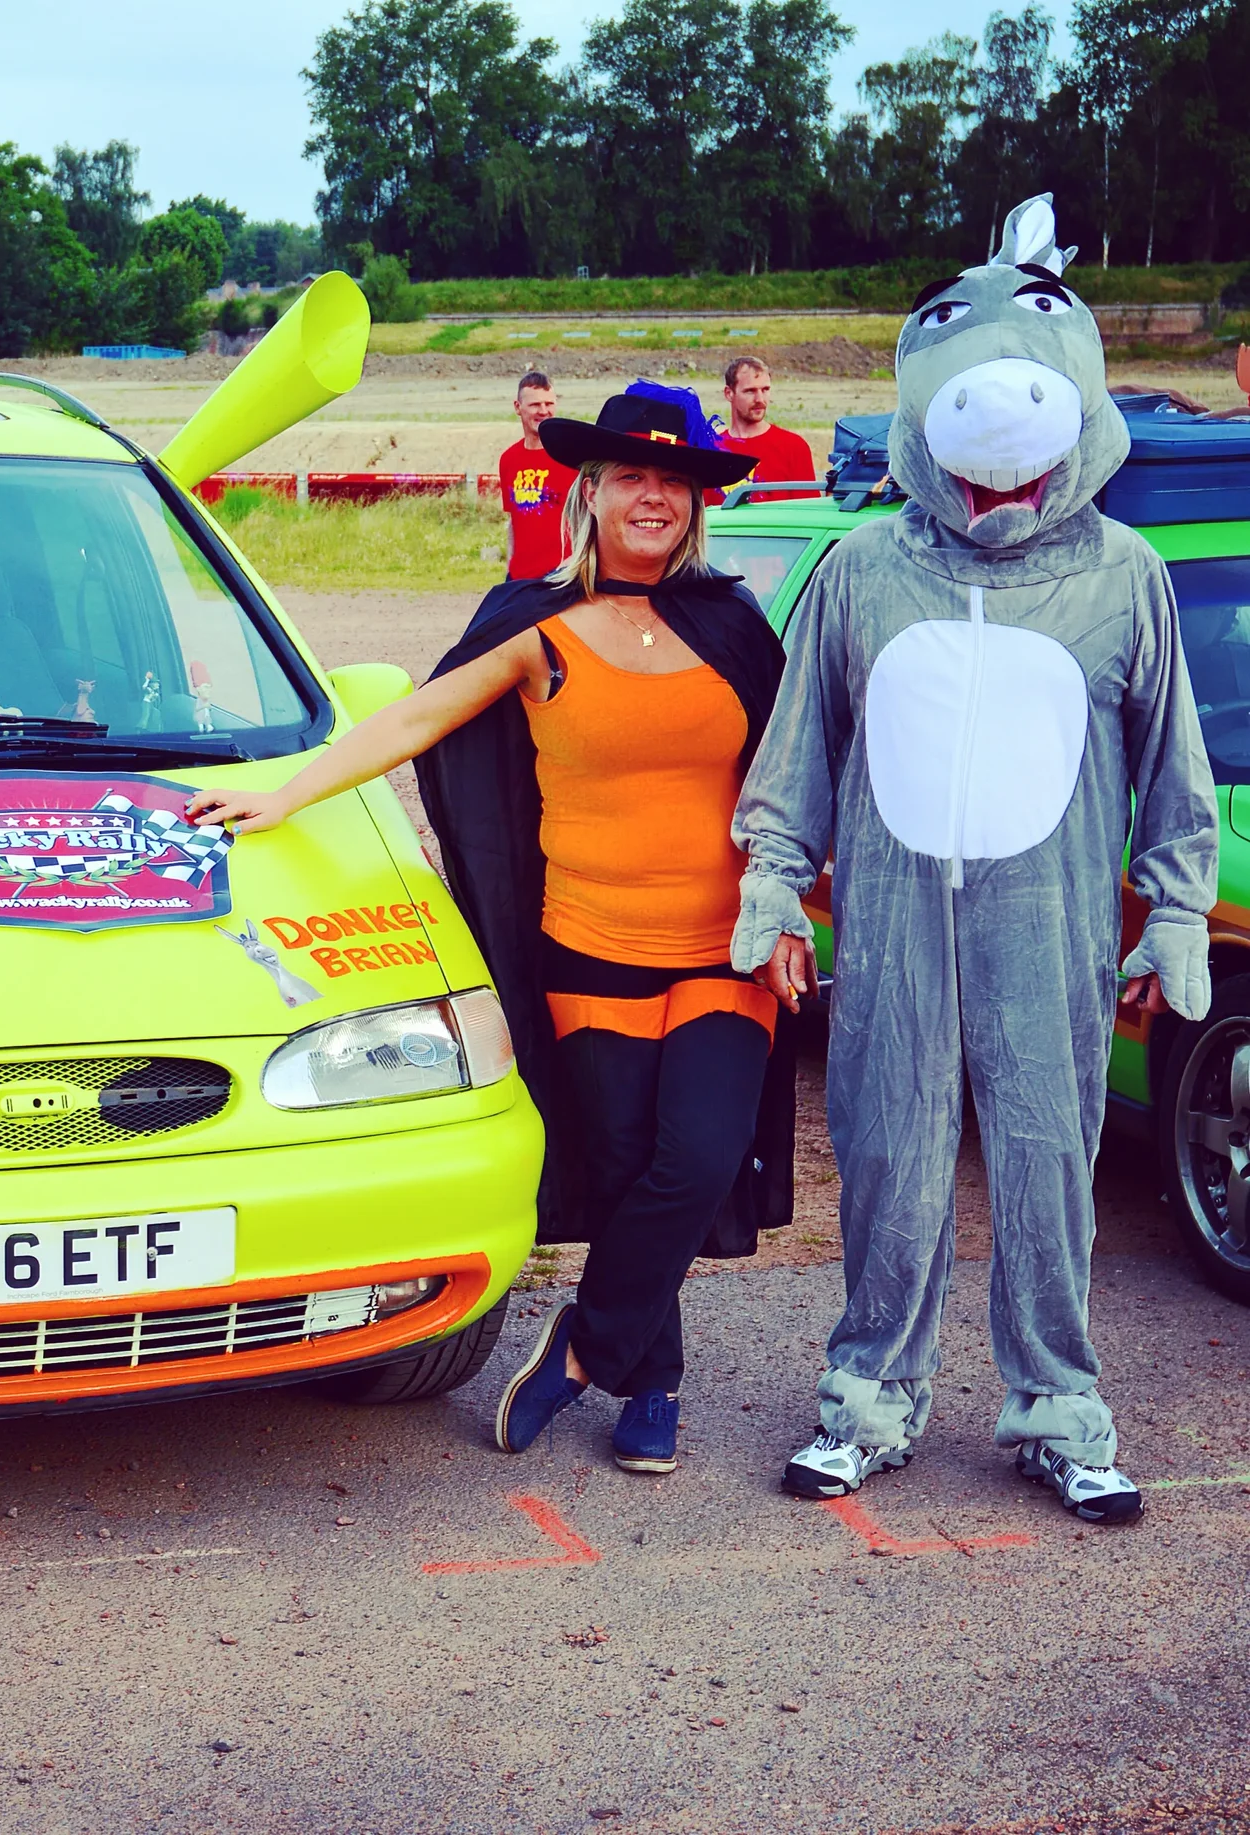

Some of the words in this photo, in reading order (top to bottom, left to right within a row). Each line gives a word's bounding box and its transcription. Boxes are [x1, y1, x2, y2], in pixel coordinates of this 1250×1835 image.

[513, 469, 549, 492] ART
[63, 830, 172, 856] Rally
[310, 940, 438, 978] BRIAN
[63, 1221, 181, 1286] ETF
[7, 1292, 40, 1300] Inchcape
[41, 1290, 58, 1298] Ford
